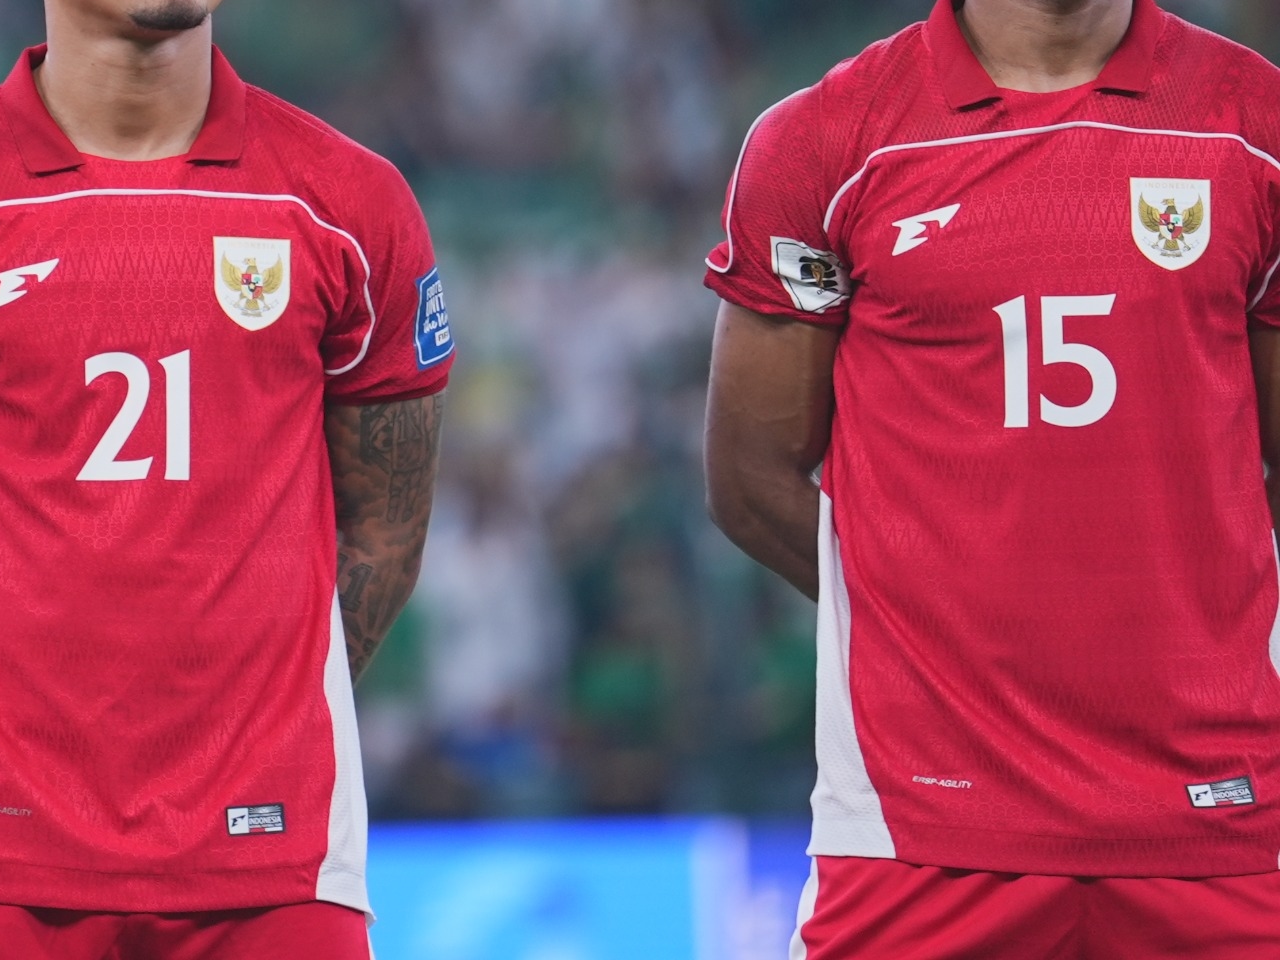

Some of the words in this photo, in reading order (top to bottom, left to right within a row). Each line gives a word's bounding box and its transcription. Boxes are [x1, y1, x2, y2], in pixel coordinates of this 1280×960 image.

[76, 350, 191, 481] 21
[992, 293, 1117, 428] 15
[1213, 788, 1251, 799] INDONESIA
